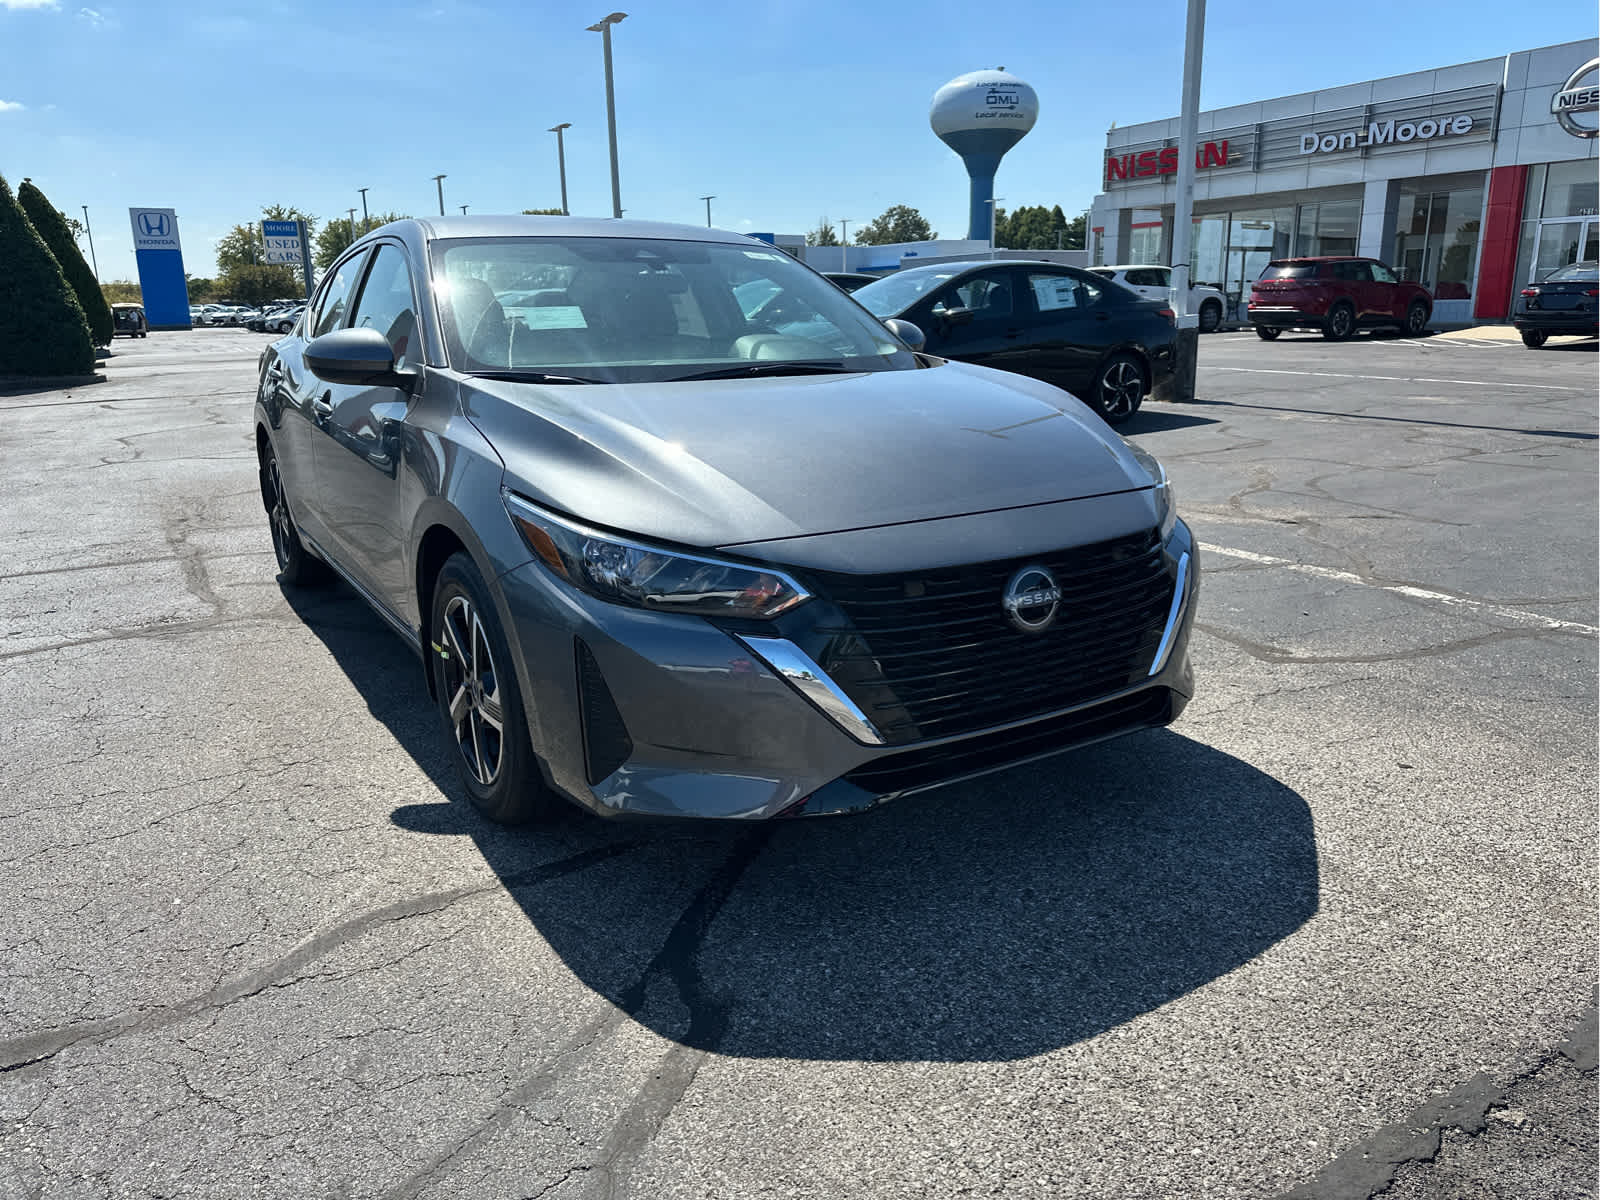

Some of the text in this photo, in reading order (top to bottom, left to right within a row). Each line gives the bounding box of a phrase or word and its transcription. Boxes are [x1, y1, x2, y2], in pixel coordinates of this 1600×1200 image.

[986, 95, 1019, 105] OMU
[1300, 115, 1474, 155] Don Moore
[1107, 140, 1228, 181] NISSN
[265, 224, 297, 232] MOORE
[266, 239, 300, 249] USED
[267, 251, 302, 262] CARS
[1007, 590, 1060, 608] NISSAN
